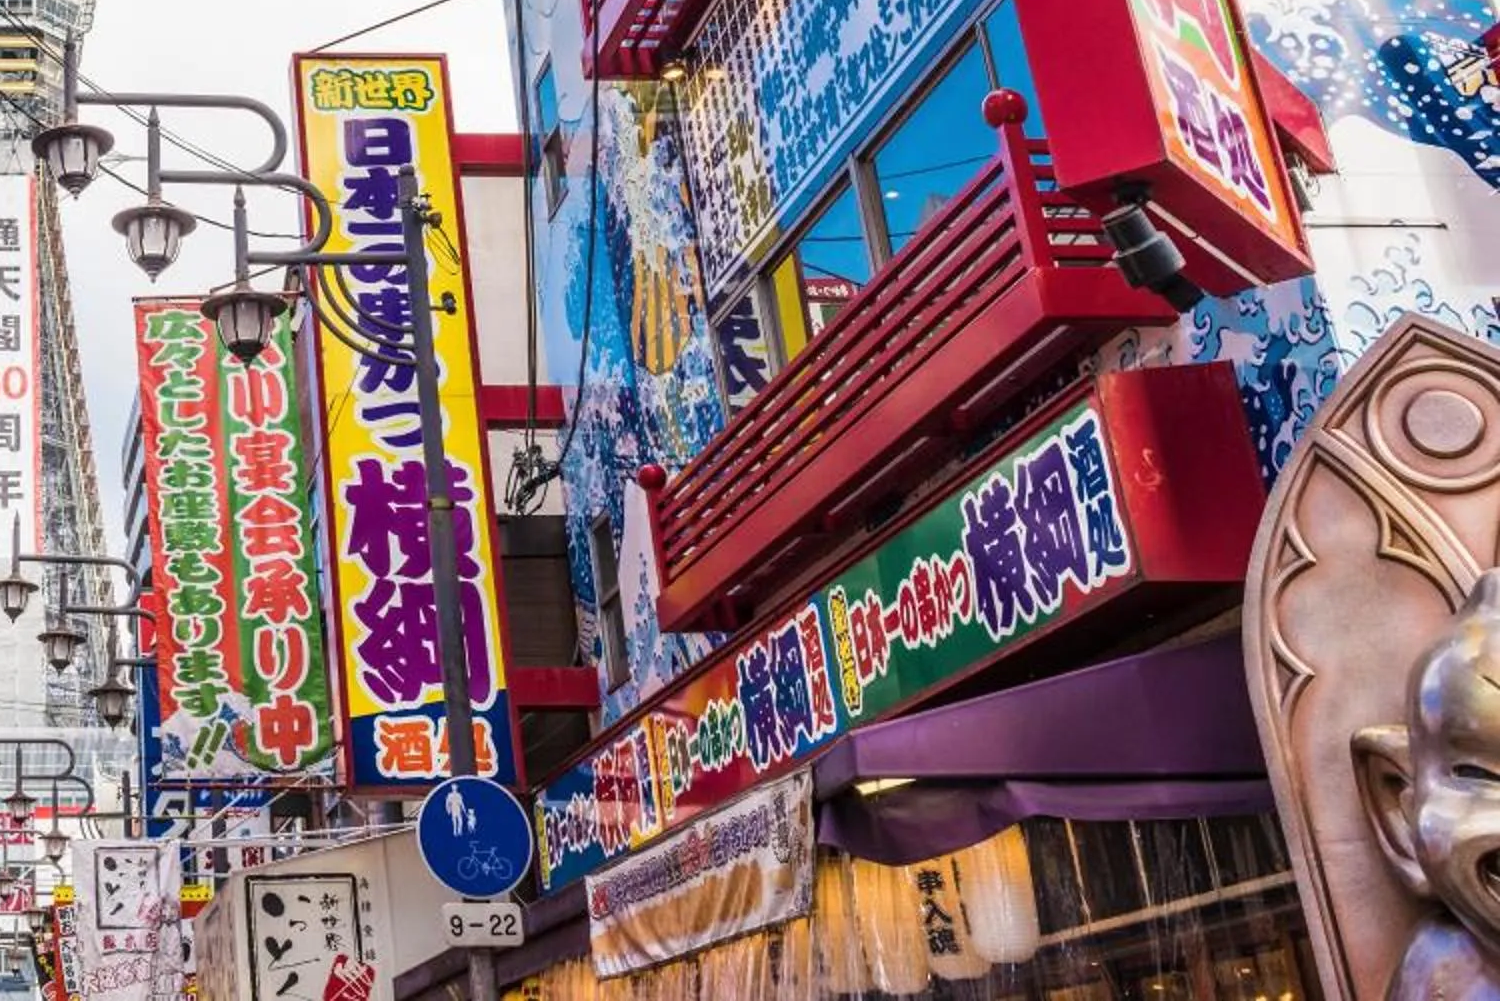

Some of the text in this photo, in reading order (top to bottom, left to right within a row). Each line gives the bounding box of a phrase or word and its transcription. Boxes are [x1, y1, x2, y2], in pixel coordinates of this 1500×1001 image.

[312, 71, 433, 111] 新世界
[224, 317, 318, 768] 小宴会承り中
[851, 556, 971, 680] 日本一の串かつ
[964, 440, 1089, 637] 横綱
[1065, 412, 1128, 580] 酒処
[737, 623, 815, 771] 横綱
[450, 915, 518, 936] 9-22
